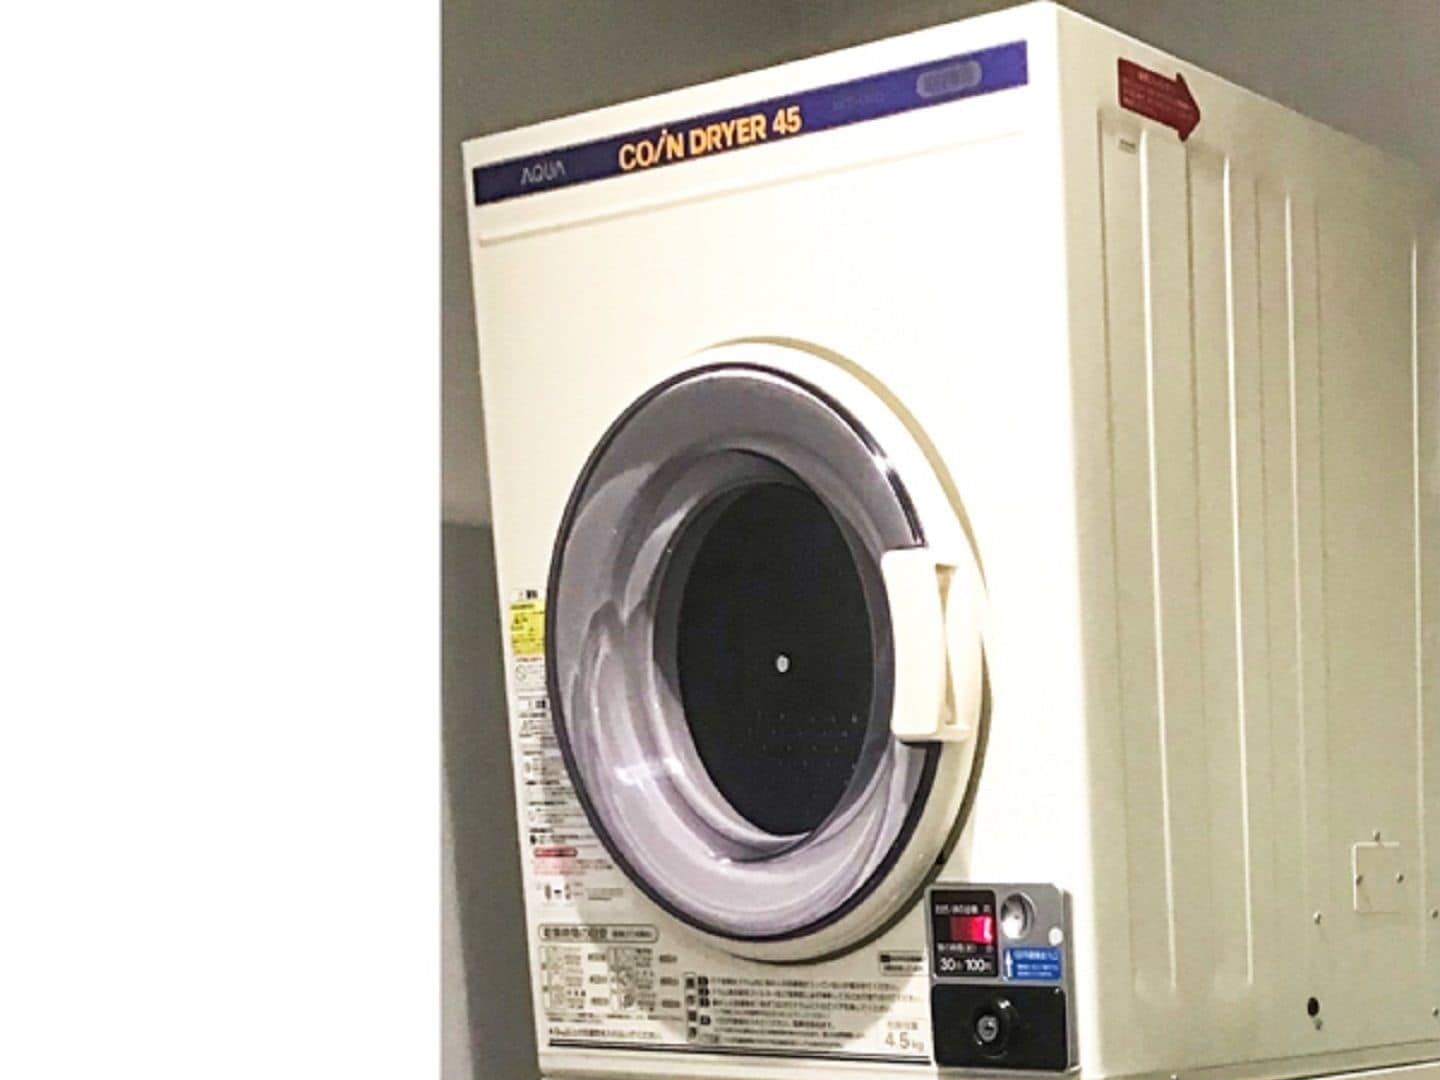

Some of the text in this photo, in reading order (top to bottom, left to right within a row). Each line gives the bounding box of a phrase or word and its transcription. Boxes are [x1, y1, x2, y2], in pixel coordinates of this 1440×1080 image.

[520, 160, 566, 185] AQUA
[689, 114, 766, 155] DRYER
[772, 105, 802, 134] 45
